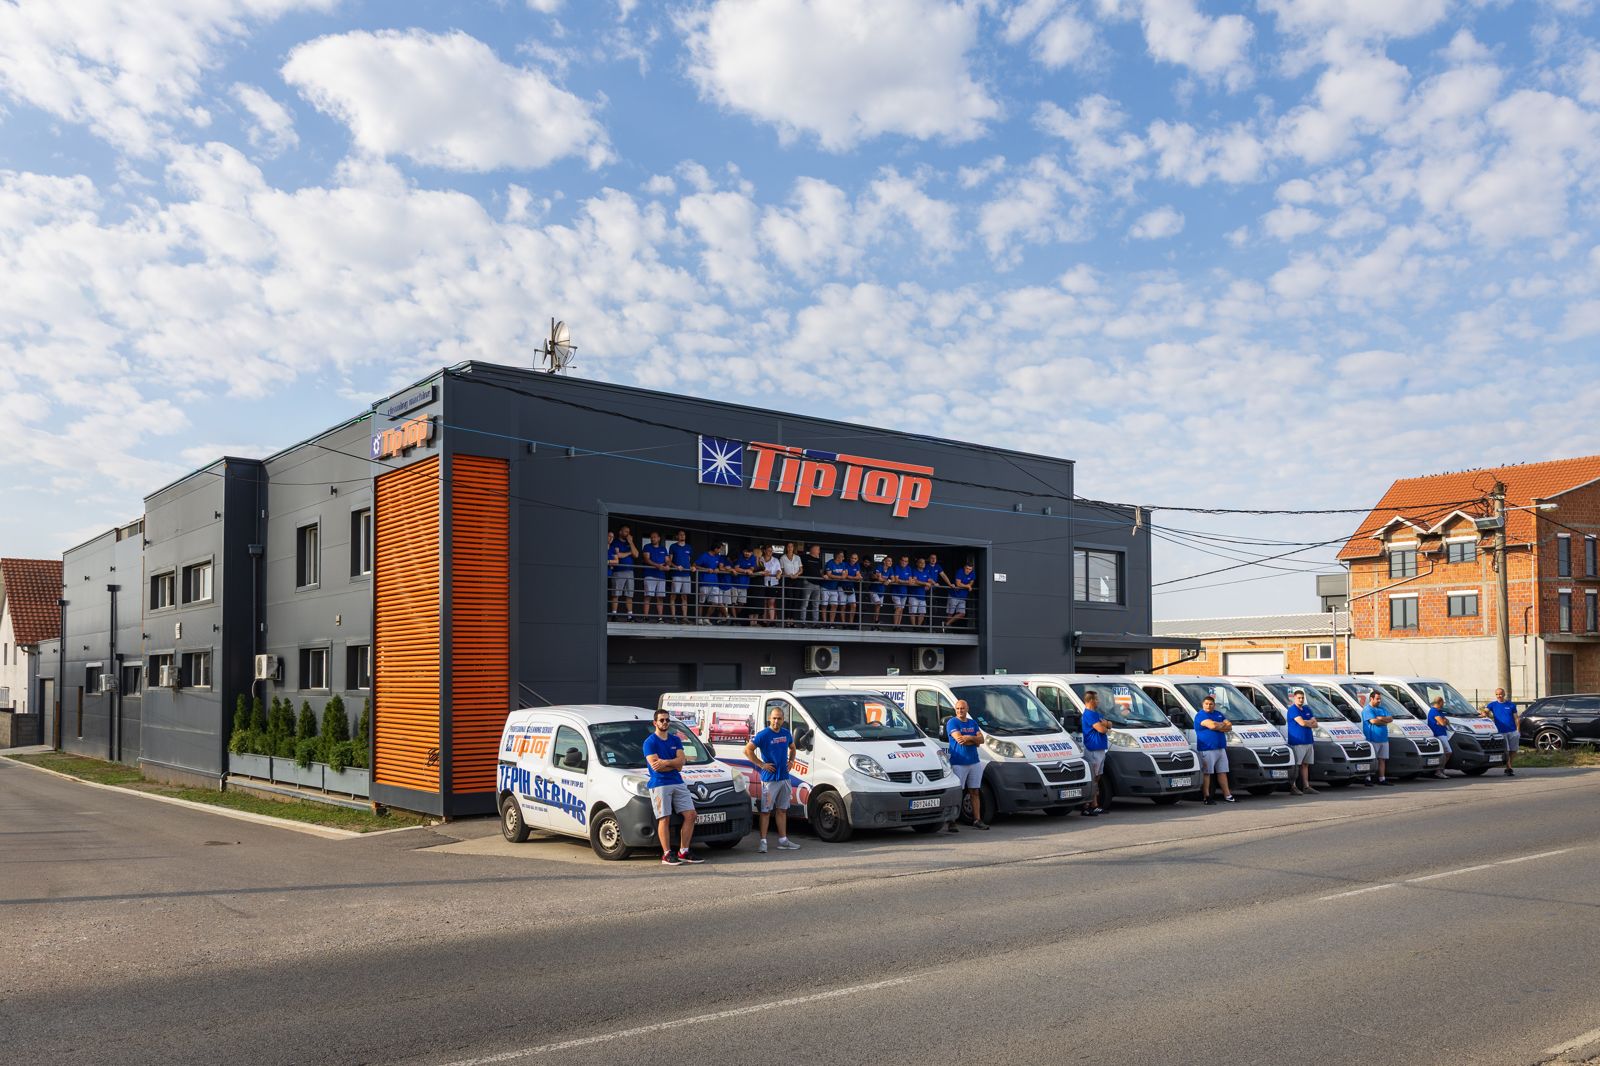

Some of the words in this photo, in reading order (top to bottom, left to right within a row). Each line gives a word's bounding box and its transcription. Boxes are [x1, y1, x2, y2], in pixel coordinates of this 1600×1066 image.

[1027, 744, 1050, 752] TEPIH
[1049, 742, 1073, 751] SERVIS
[499, 765, 531, 795] TEPIH
[534, 775, 587, 825] SERVIS
